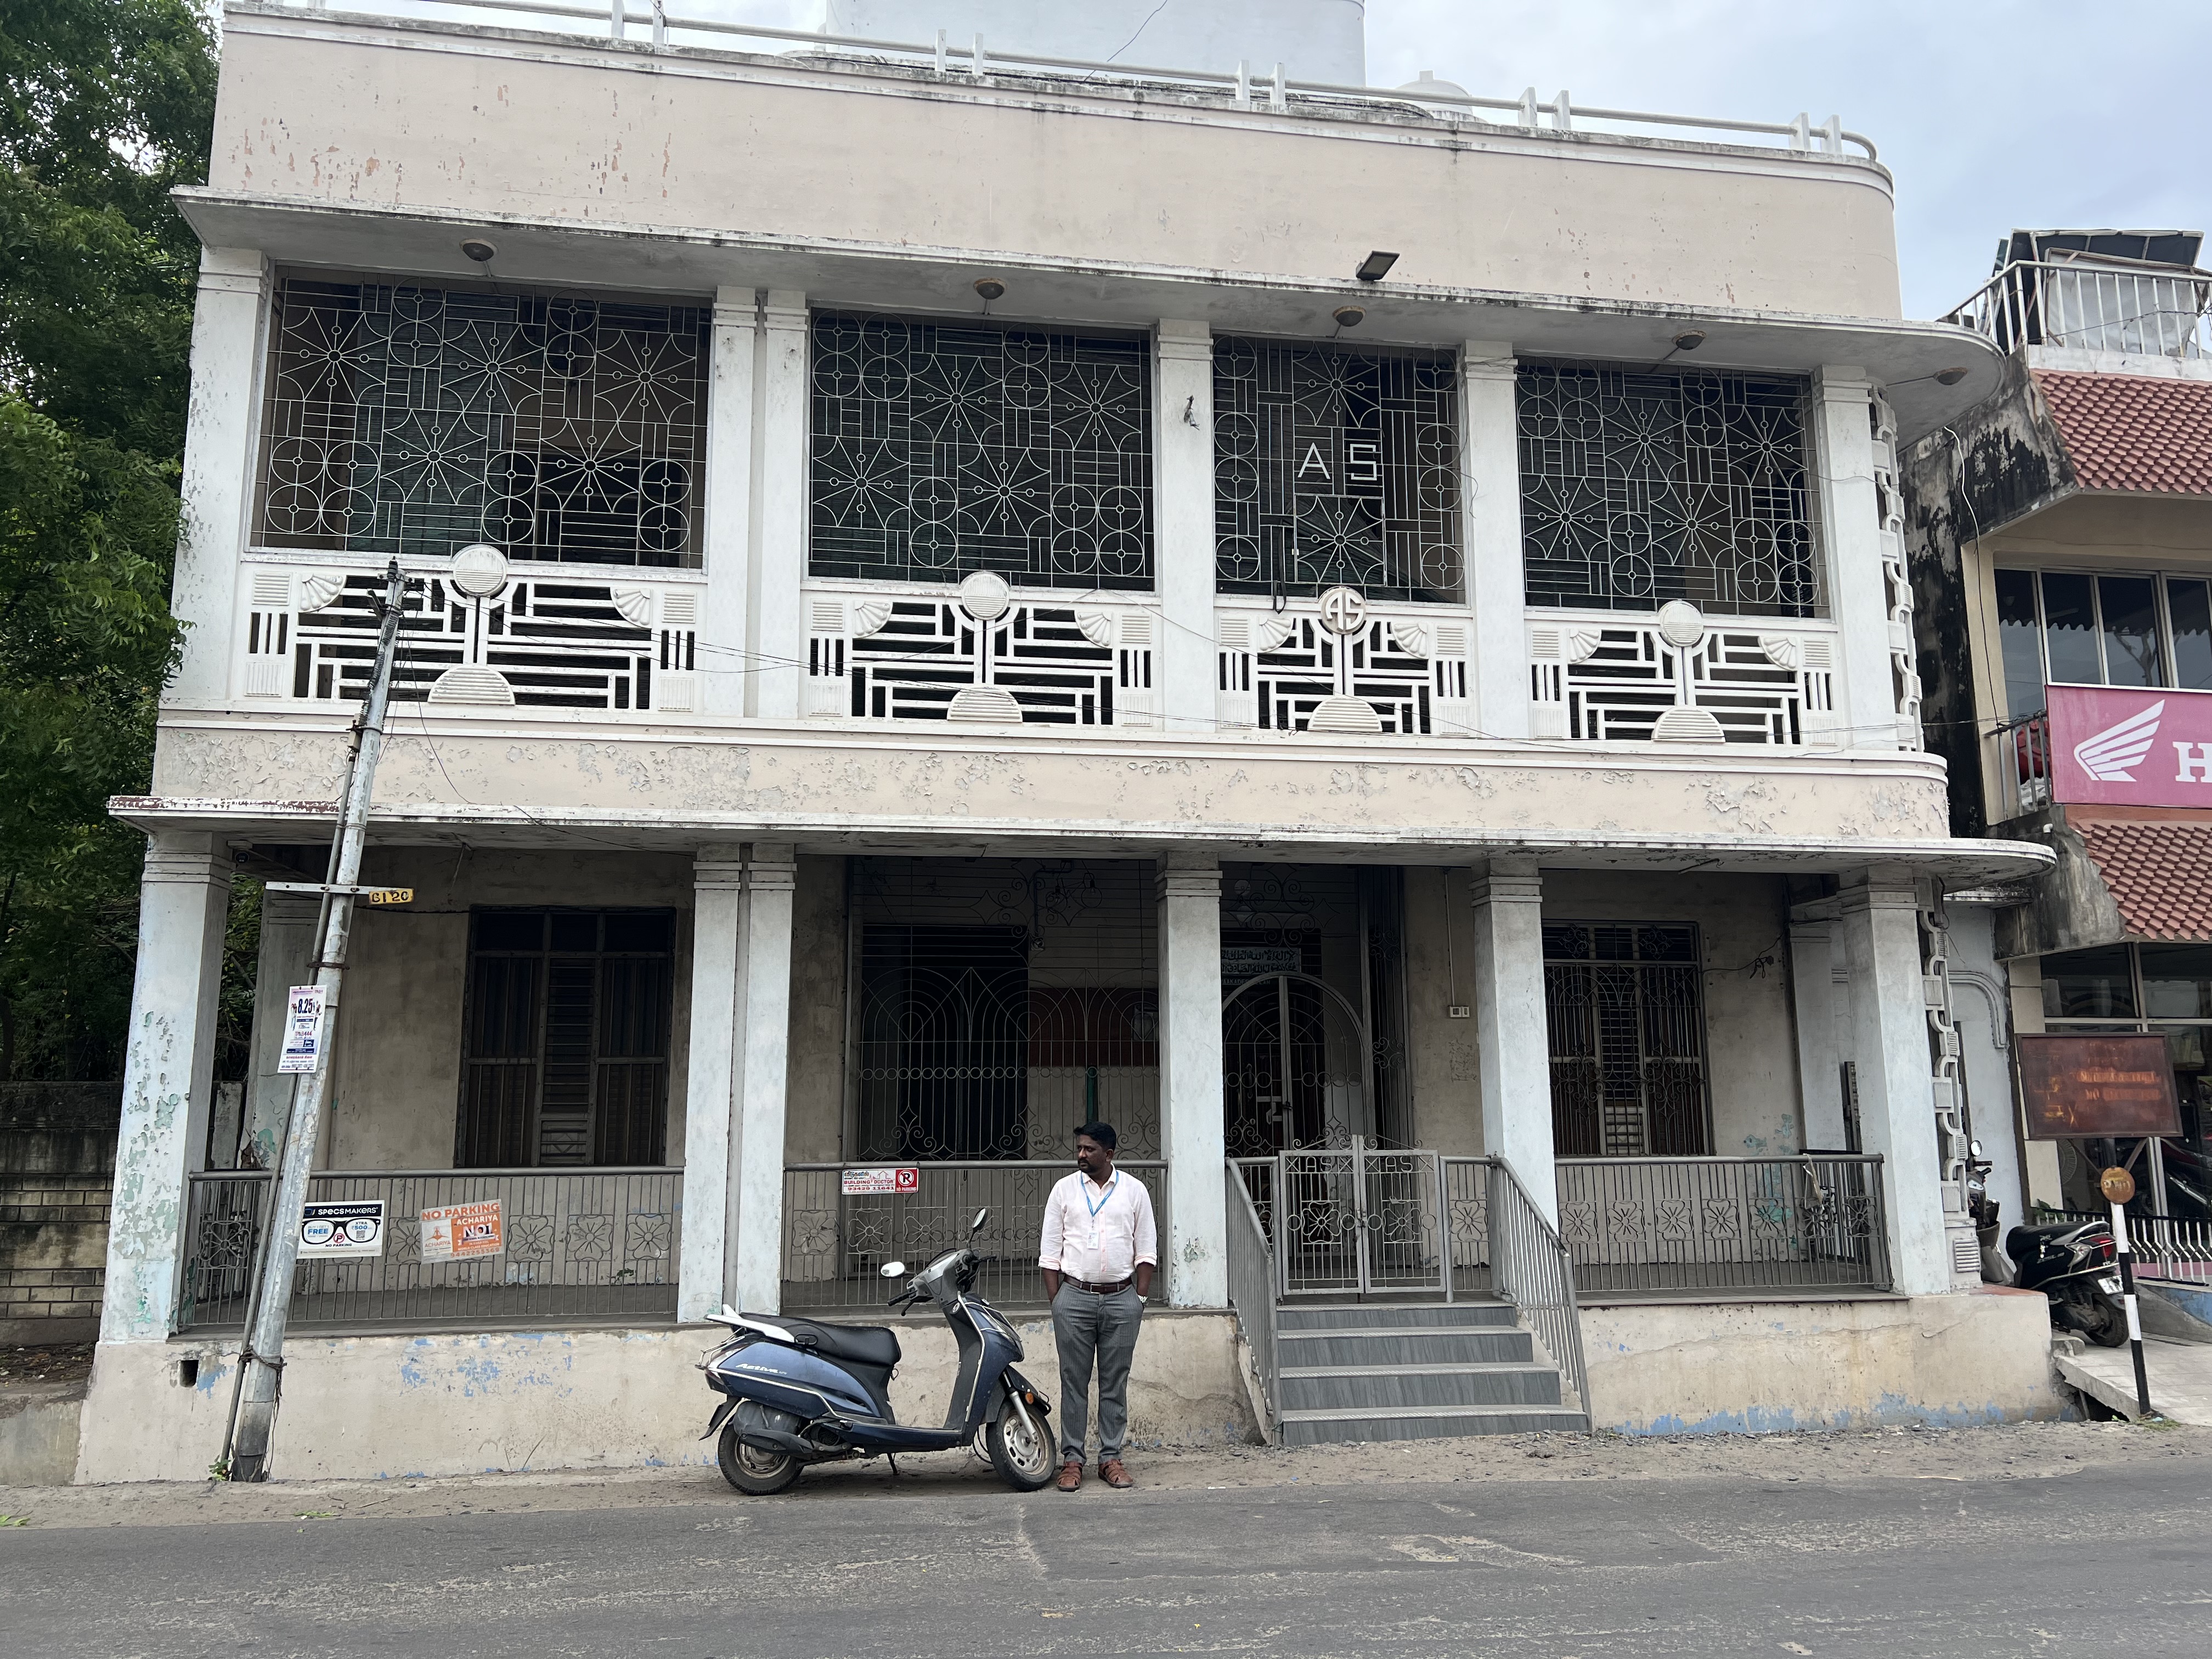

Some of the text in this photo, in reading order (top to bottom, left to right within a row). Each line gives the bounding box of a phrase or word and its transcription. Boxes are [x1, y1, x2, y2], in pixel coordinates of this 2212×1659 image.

[298, 998, 313, 1013] 8.25
[421, 1203, 500, 1221] NO PARKING
[456, 1215, 498, 1226] ACHARIYA
